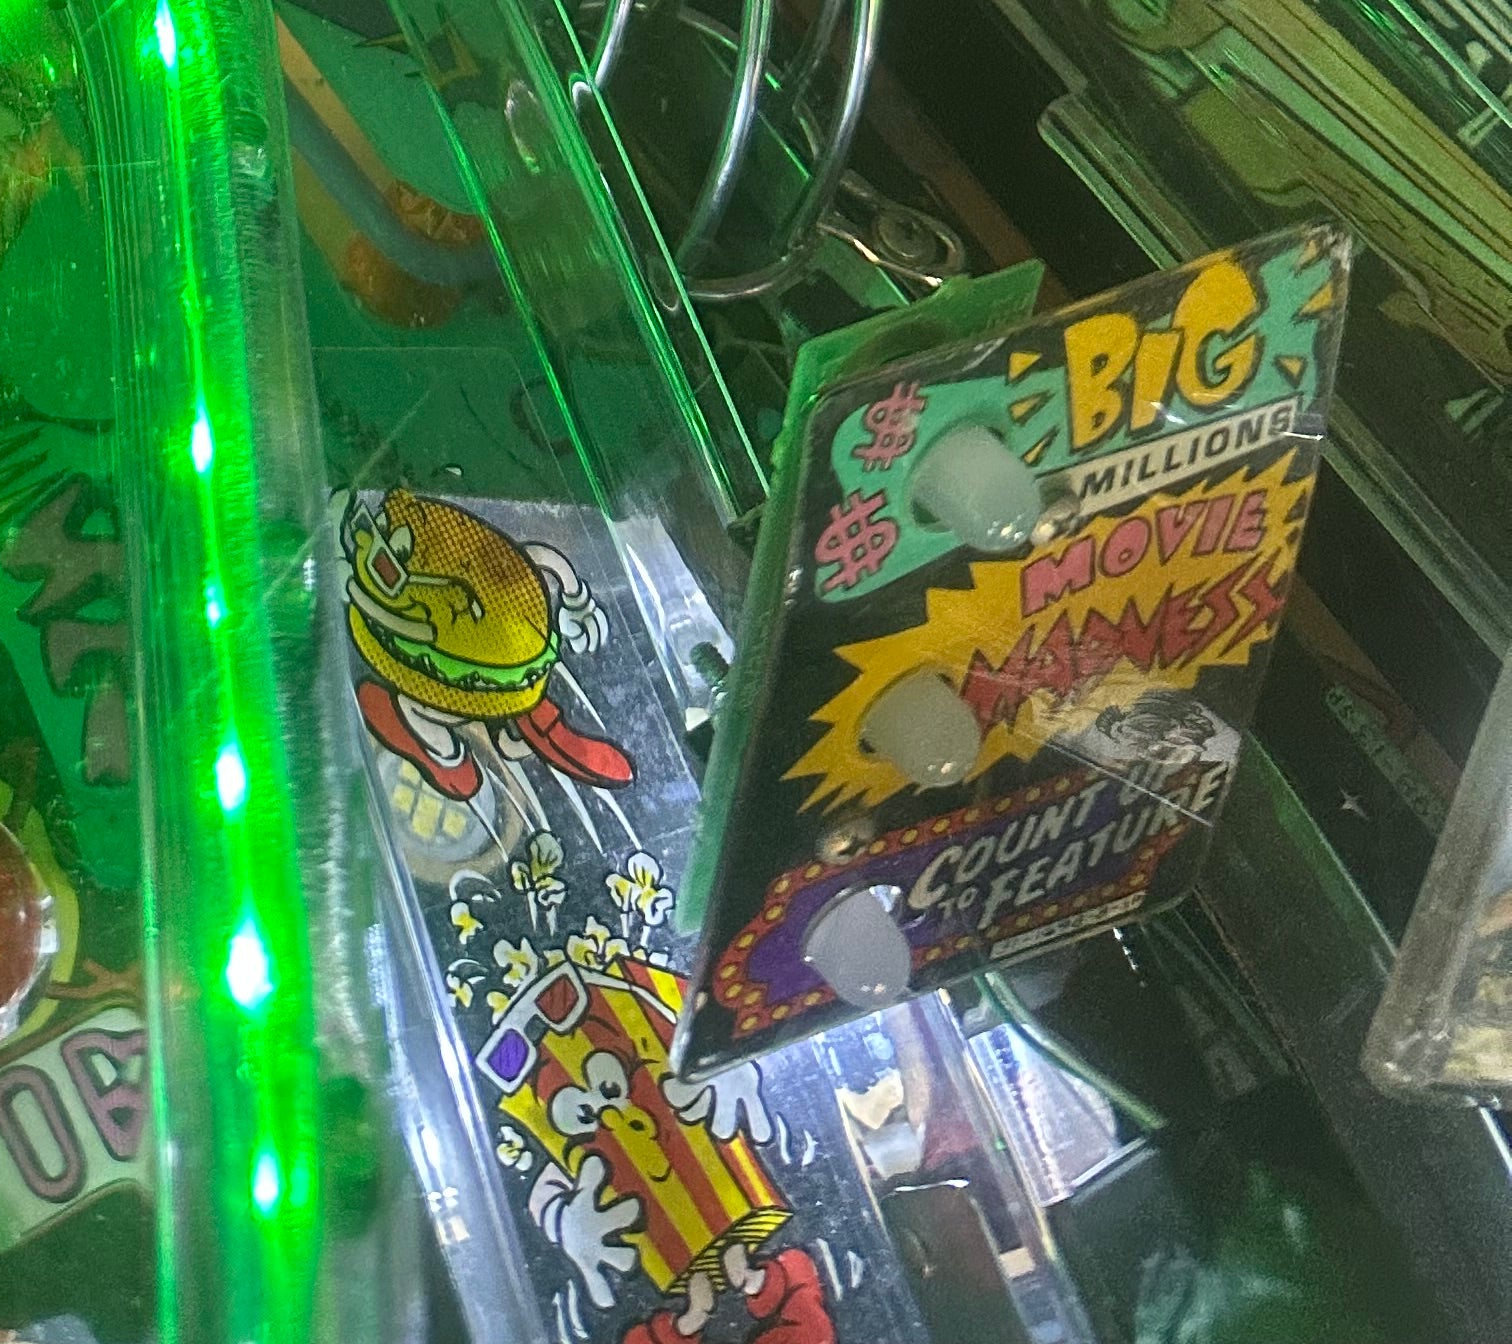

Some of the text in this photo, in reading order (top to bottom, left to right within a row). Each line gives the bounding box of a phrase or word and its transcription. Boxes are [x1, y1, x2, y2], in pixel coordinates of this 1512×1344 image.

[1065, 258, 1260, 452] BIG
[1080, 406, 1295, 499] MILLIONS
[1022, 490, 1267, 617] MOVIE
[962, 554, 1284, 737] MADNESS
[909, 779, 1110, 910] COUNT
[939, 886, 978, 919] TO
[978, 762, 1230, 930] FEATURE
